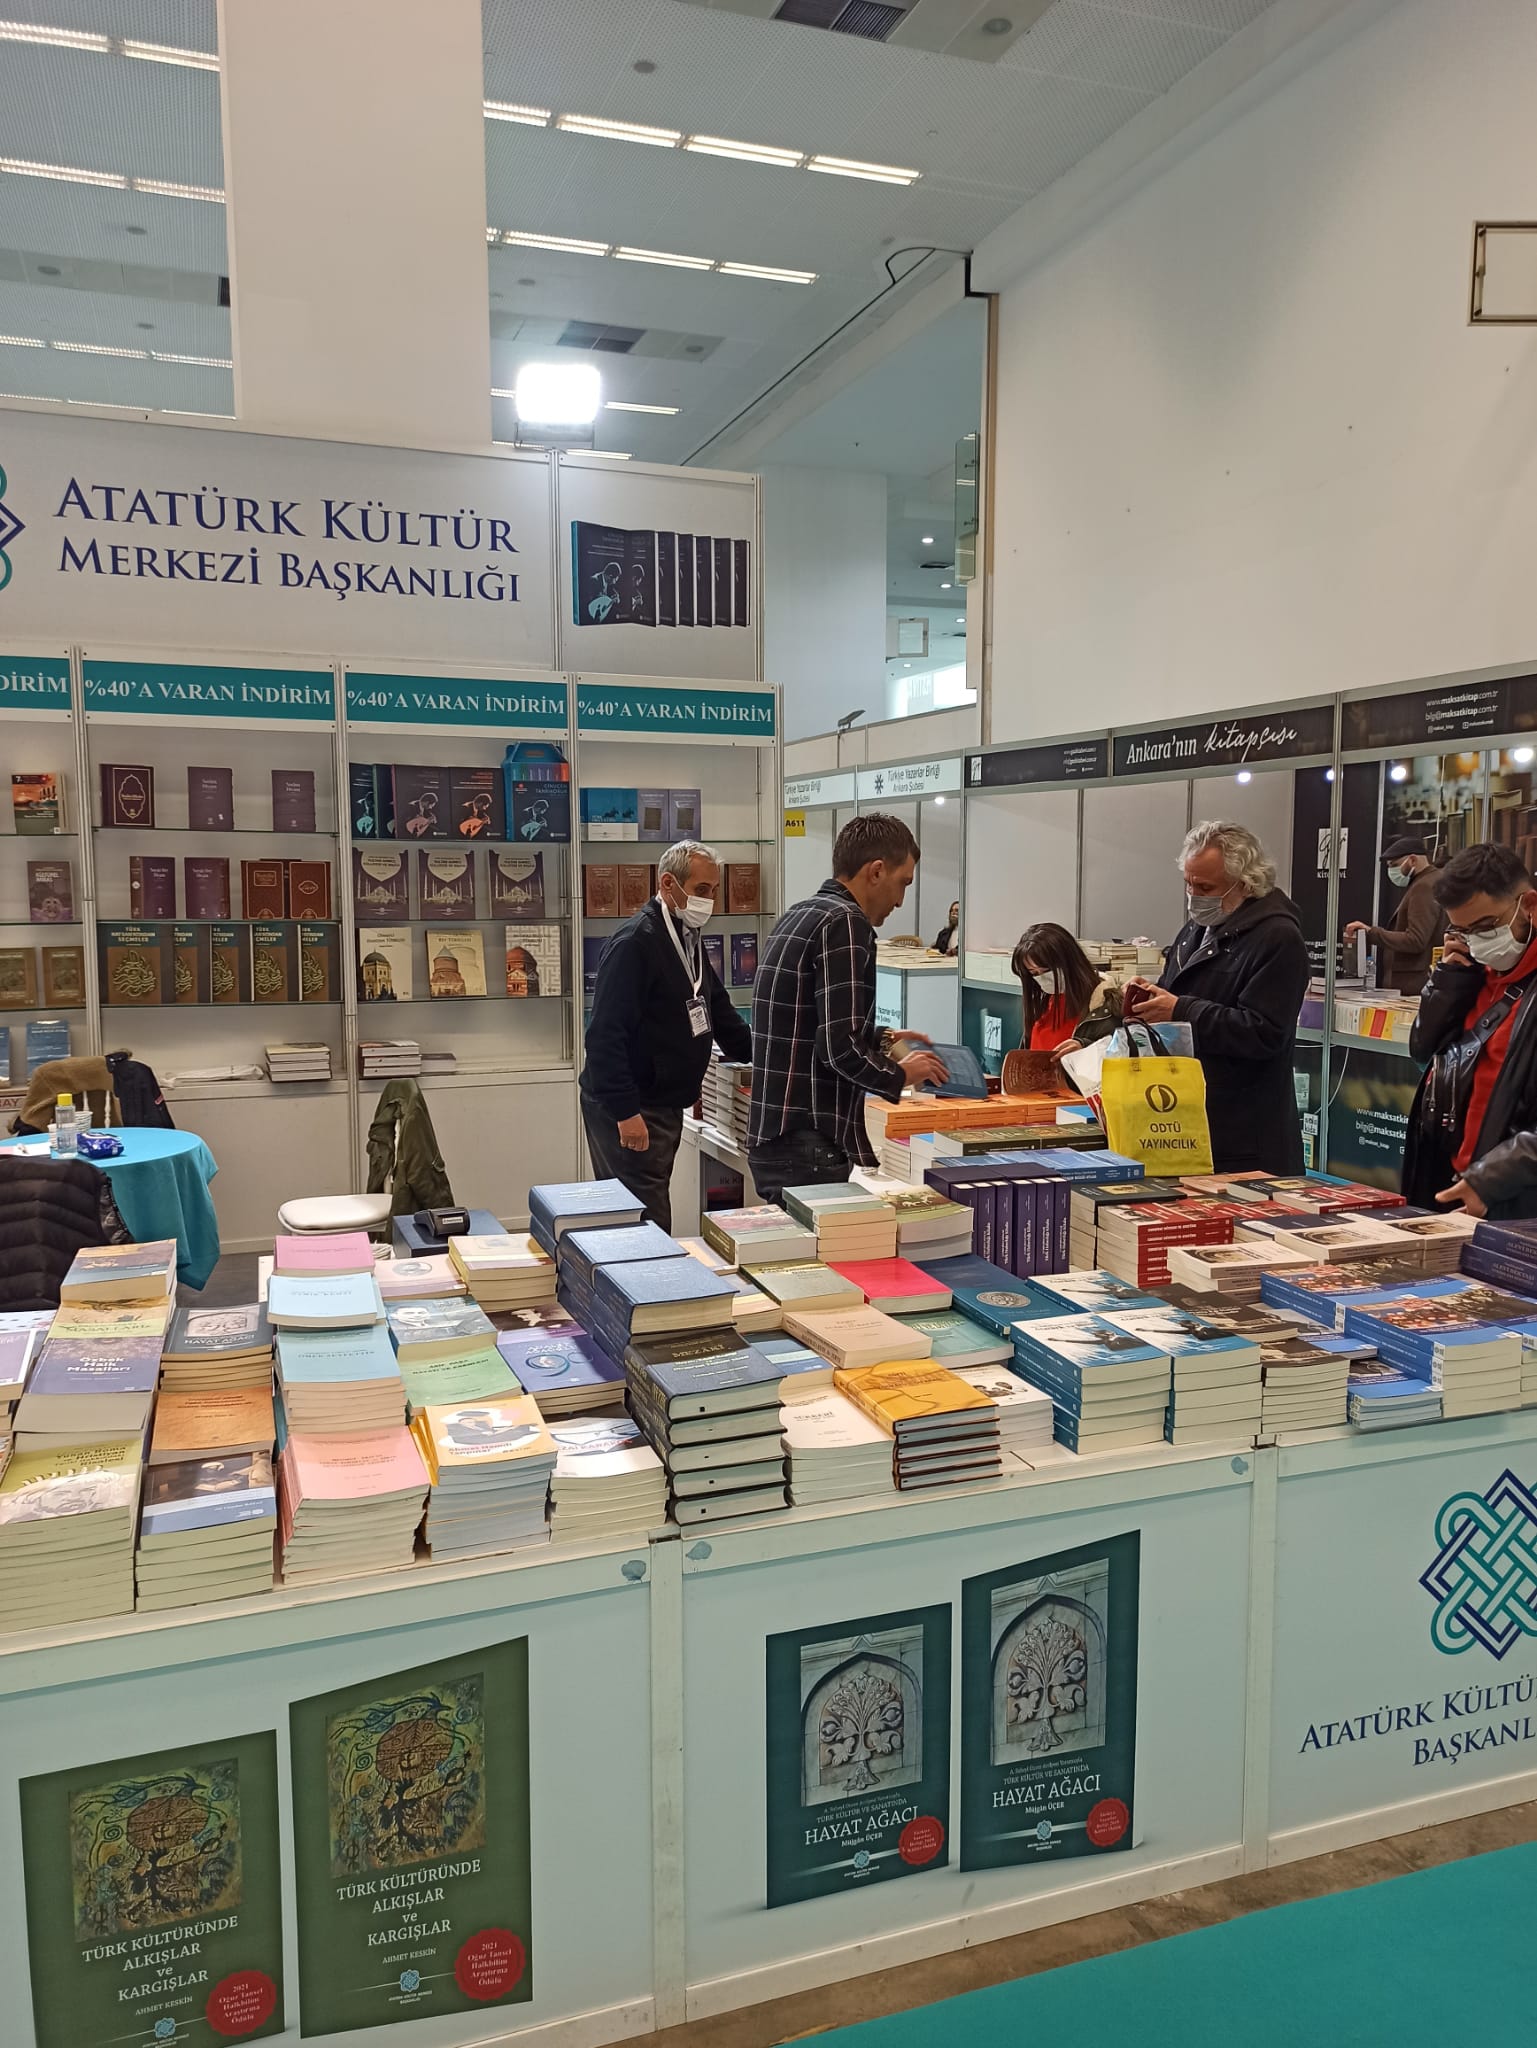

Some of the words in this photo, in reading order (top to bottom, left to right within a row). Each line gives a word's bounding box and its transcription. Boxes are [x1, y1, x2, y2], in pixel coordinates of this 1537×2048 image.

[53, 477, 306, 537] ATATÜRK
[320, 499, 520, 553] KÜLTÜR
[57, 536, 262, 585] MERKEZİ
[277, 552, 521, 602] BAŞKANLIĞI
[158, 682, 235, 701] VARAN
[241, 683, 331, 706] İNDİRİM
[412, 693, 479, 711] VARAN
[485, 693, 565, 714] İNDİRİM
[635, 703, 696, 720] VARAN
[701, 702, 772, 723] İNDİRİM
[1126, 733, 1197, 764] Ankara'nın
[785, 818, 805, 828] A611
[1150, 1121, 1181, 1133] ODTÜ
[1139, 1138, 1198, 1150] YAYINCILIK
[1298, 1705, 1435, 1754] ATATÜRK
[1443, 1674, 1537, 1720] KÜLTÜ
[992, 1784, 1045, 1808] HAYAT
[1049, 1774, 1101, 1799] AĞACI
[805, 1817, 863, 1845] HAYAT
[866, 1805, 919, 1831] AĞACI
[336, 1881, 377, 1900] TÜRK
[380, 1859, 481, 1892] KÜLTÜRÜNDE
[372, 1887, 445, 1914] ALKIŞLAR
[402, 1911, 418, 1923] ve
[82, 1942, 128, 1962] TÜRK
[132, 1915, 238, 1950] KÜLTÜRÜNDE
[367, 1919, 452, 1946] KARGIŞLAR
[122, 1942, 202, 1972] ALKIŞLAR
[382, 1952, 409, 1965] AHMET
[409, 1948, 437, 1960] KESKİN
[156, 1966, 173, 1977] ve
[118, 1969, 209, 2002] KARGIŞLAR
[135, 2003, 164, 2017] AHMET
[164, 1996, 193, 2011] KESKİN
